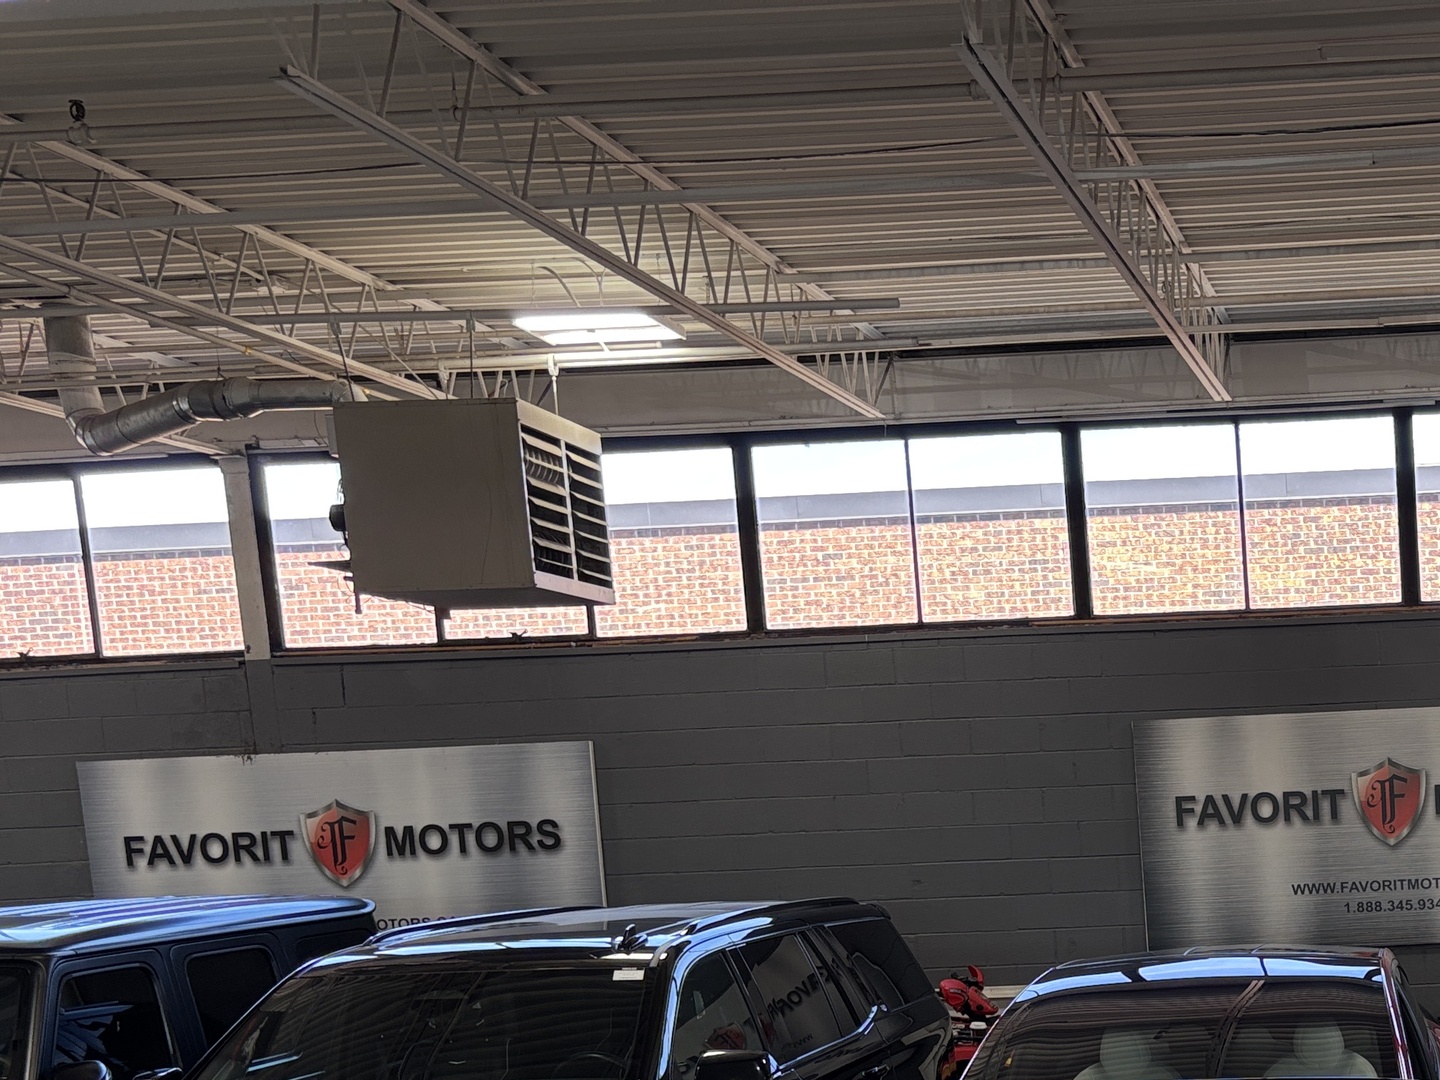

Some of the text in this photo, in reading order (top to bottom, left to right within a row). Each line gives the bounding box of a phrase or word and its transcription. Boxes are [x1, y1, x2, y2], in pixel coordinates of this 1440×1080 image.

[1174, 788, 1345, 827] FAVORIT
[122, 829, 294, 868] FAVORIT
[384, 819, 562, 858] MOTORS
